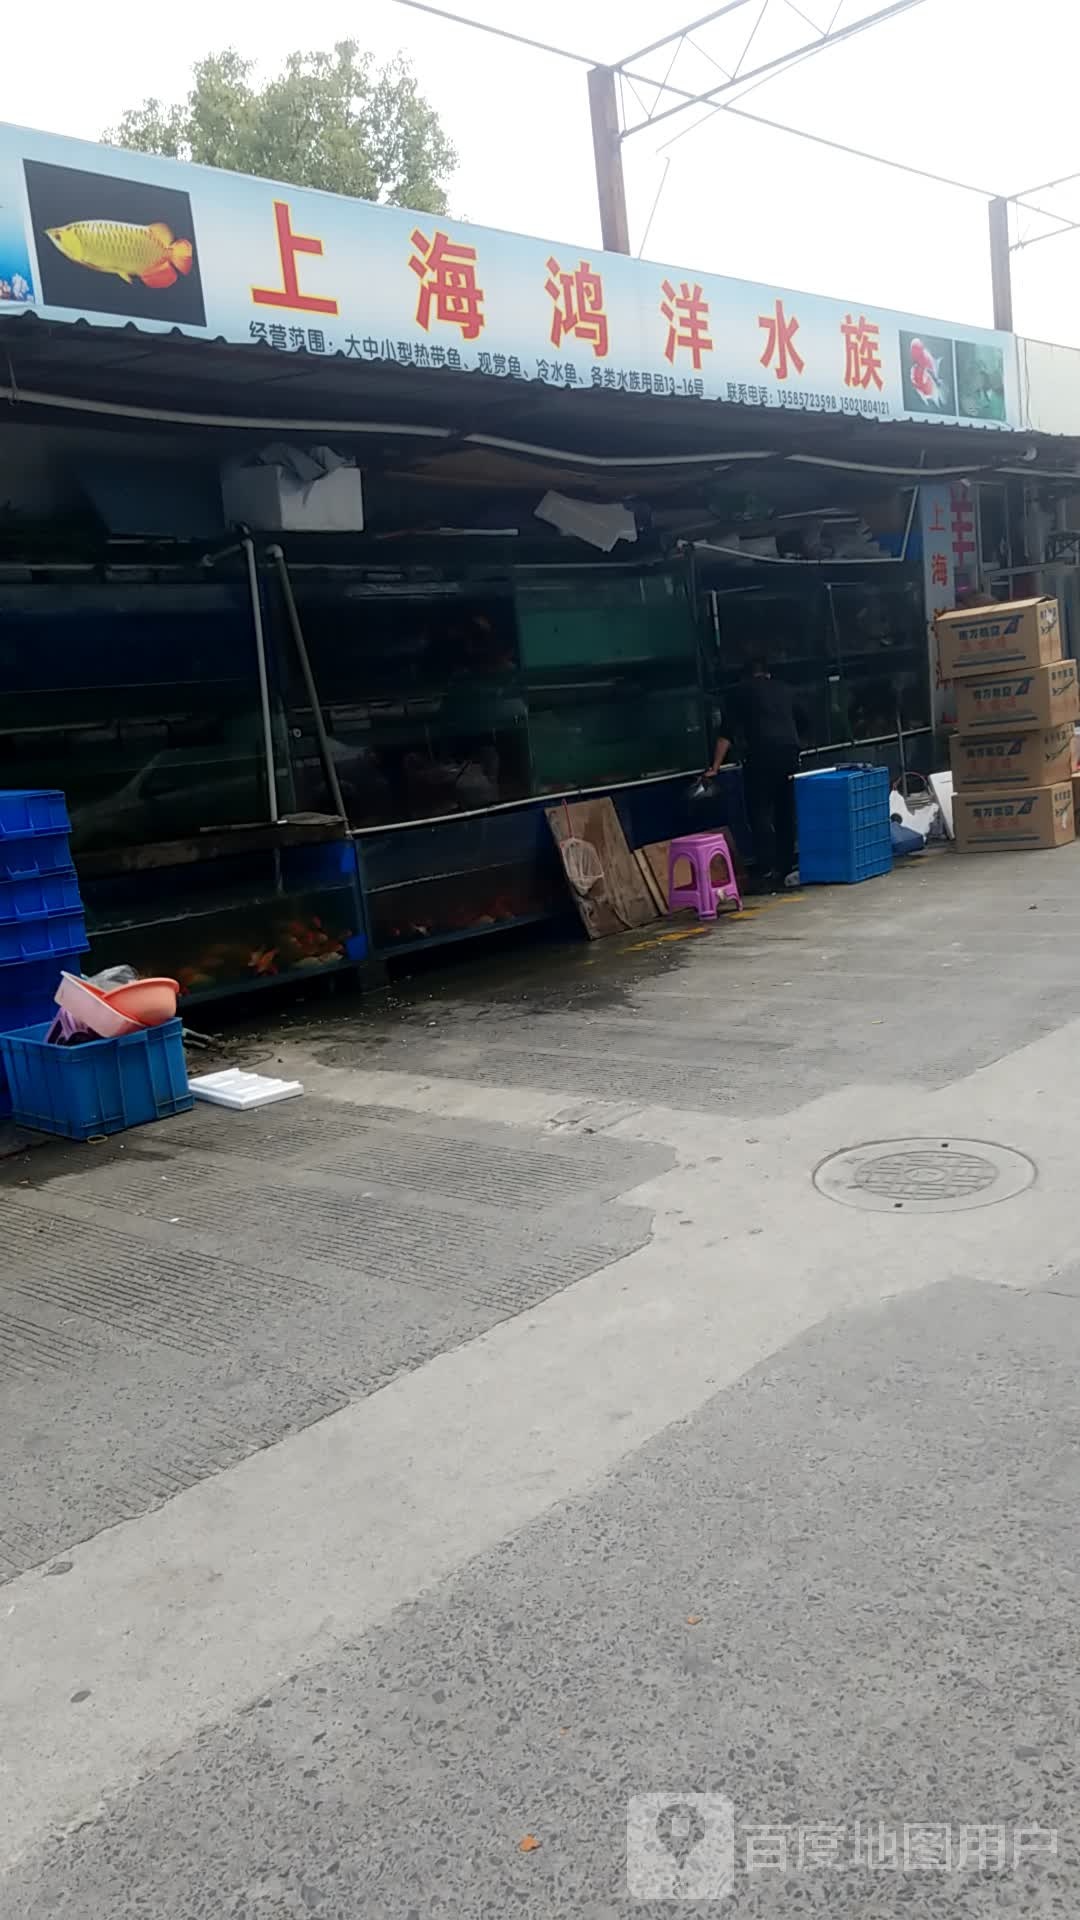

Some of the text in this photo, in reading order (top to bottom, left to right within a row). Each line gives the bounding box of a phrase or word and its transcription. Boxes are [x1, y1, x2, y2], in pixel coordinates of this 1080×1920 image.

[251, 200, 884, 391] 上海鸿洋水族
